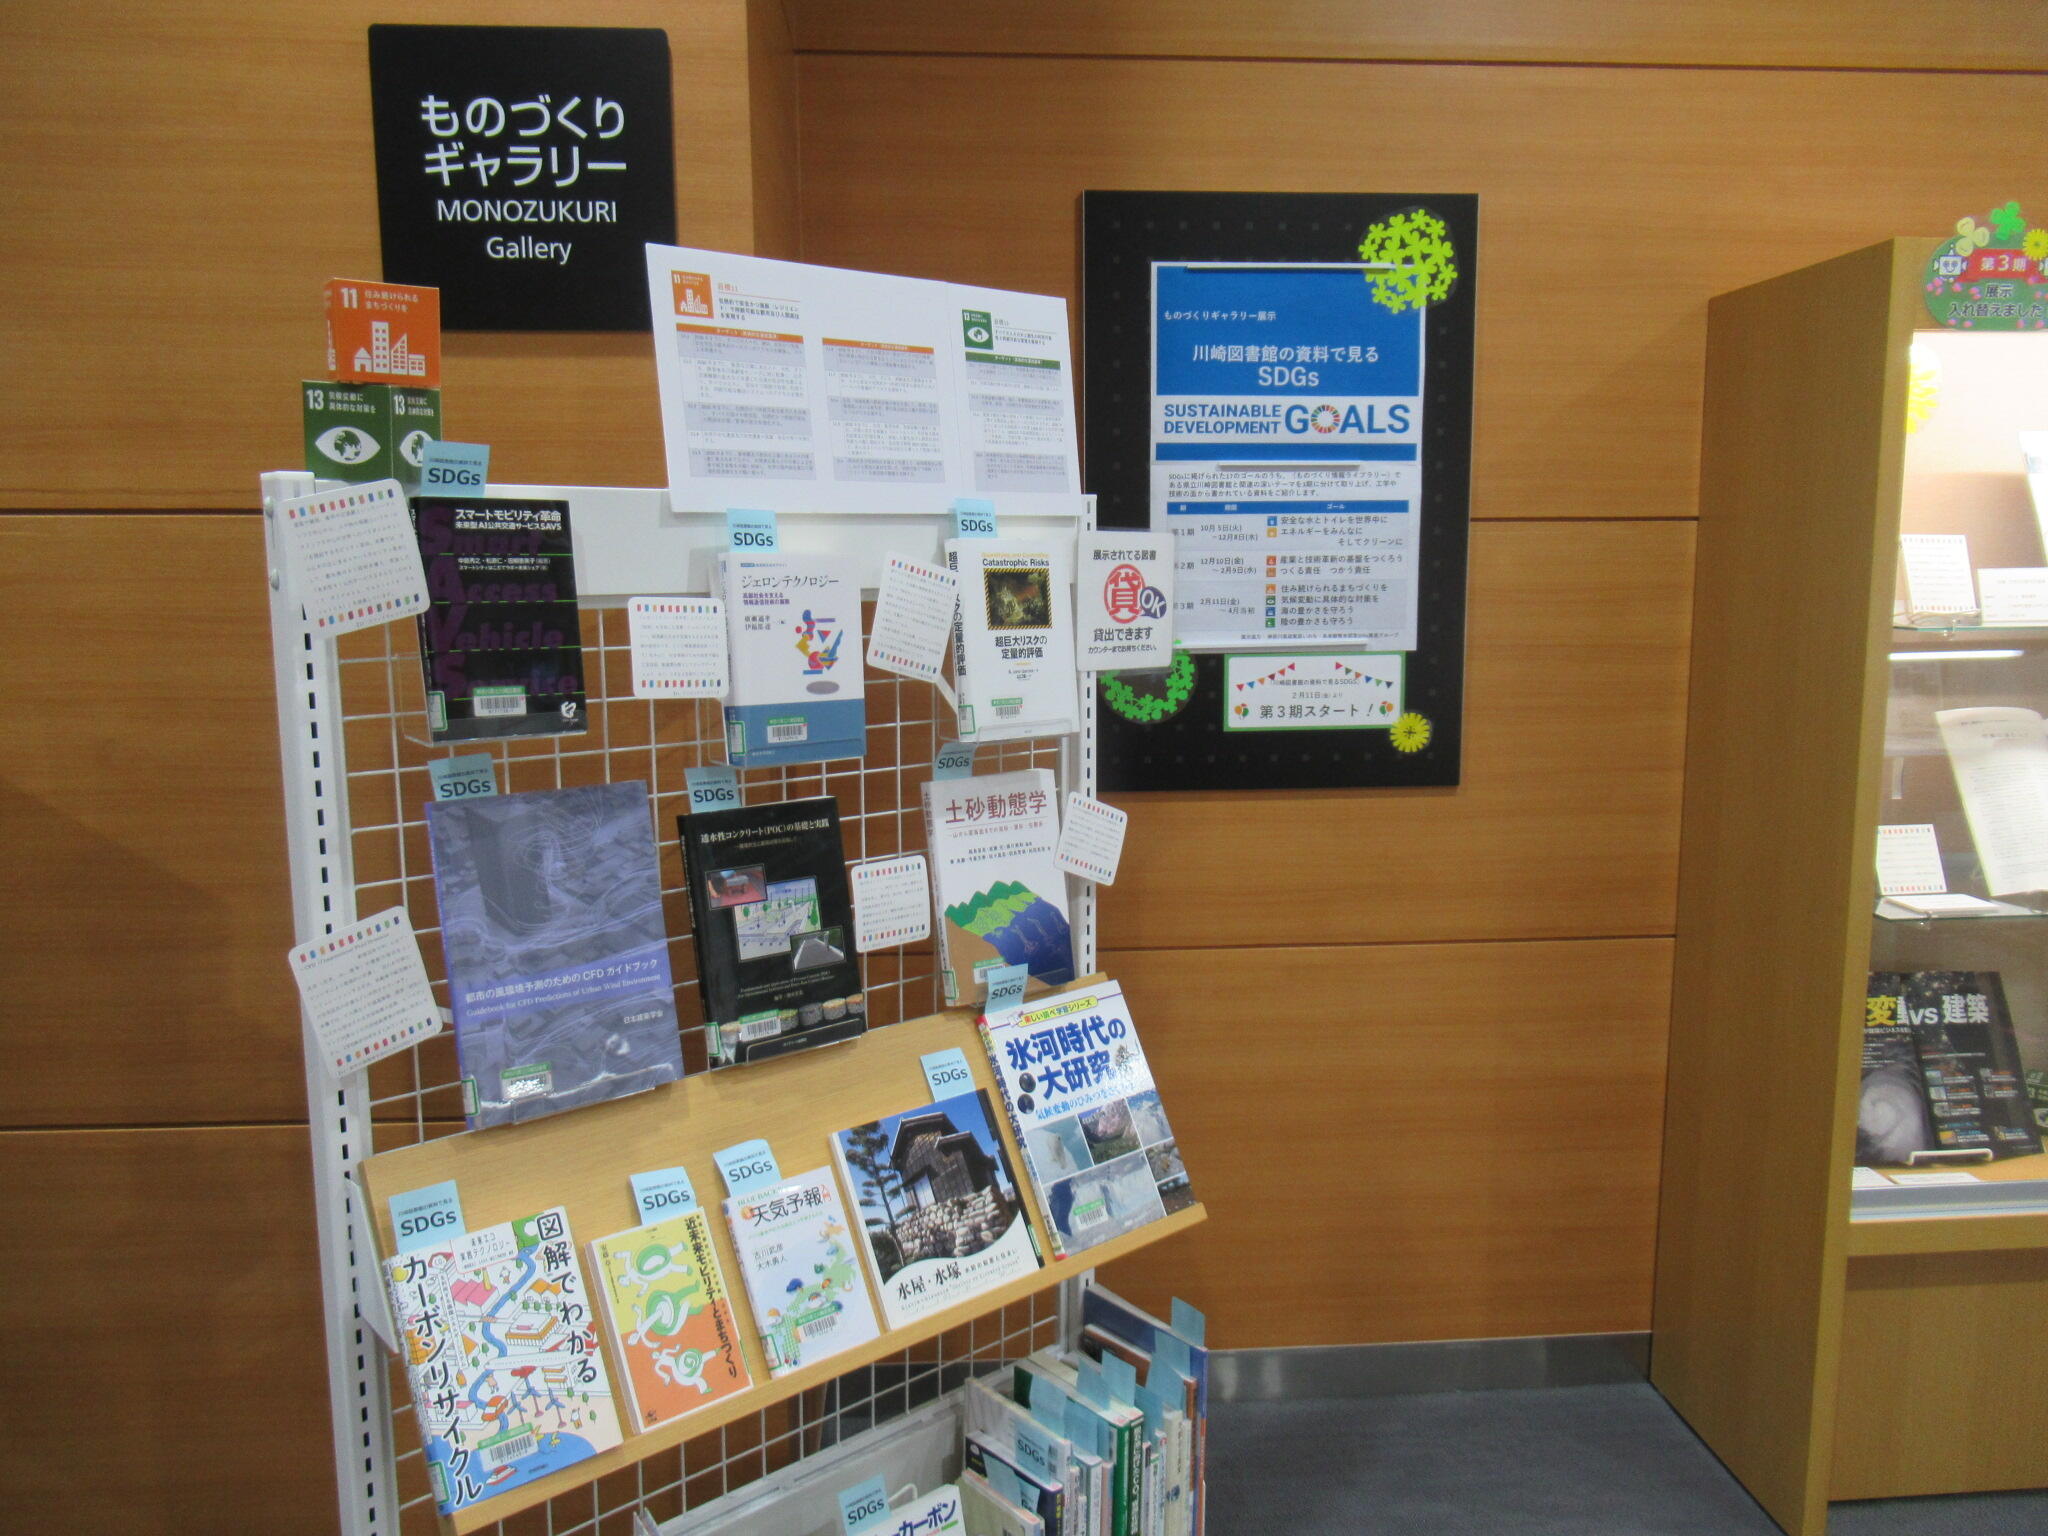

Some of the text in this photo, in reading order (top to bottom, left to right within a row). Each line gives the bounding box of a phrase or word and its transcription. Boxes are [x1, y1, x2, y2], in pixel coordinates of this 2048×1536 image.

[420, 94, 626, 139] ものづくり
[424, 142, 627, 187] ギャラリー
[437, 200, 618, 223] MONOZUKURI
[486, 236, 572, 264] Gallery
[341, 287, 359, 309] 11
[1985, 284, 2015, 299] 展示
[1163, 310, 1277, 322] ものづくりギャラリー展示
[1192, 344, 1379, 364] 川崎図書館の資料で見る
[1257, 366, 1320, 387] SDGs
[306, 389, 325, 410] 13
[393, 395, 406, 416] 13
[1163, 403, 1282, 419] SUSTAINABLE
[1284, 404, 1411, 435] GOALS
[1163, 420, 1281, 434] DEVELOPMENT
[427, 467, 481, 486] SDGs
[455, 508, 562, 522] スマートモビリティ革命
[1280, 515, 1388, 525] 安全な水とトイレを世界中に
[960, 520, 994, 532] SDGs
[1280, 526, 1363, 536] エネルギーをみんなに
[733, 532, 774, 547] SDGs
[1338, 537, 1403, 547] そしてクリーンに
[982, 558, 1050, 569] Catastrophic Risks
[1093, 549, 1157, 561] 展示されてる図書
[1280, 554, 1403, 565] 産業と技術革新の基盤をつくろう
[741, 575, 840, 589] ジェロンテクノロジー
[1280, 583, 1388, 594] 住み続けられるまちづくりを
[1108, 571, 1167, 619] 貸 OK
[995, 635, 1048, 648] 超巨大リスクの
[1093, 626, 1154, 643] 貸出できます
[1001, 647, 1044, 660] 定量的評価
[937, 757, 970, 770] SDGs
[440, 779, 492, 799] SDGs
[693, 787, 735, 803] SDGs
[945, 790, 1048, 824] 土砂動態学
[582, 968, 605, 982] CFD
[606, 958, 658, 976] ガイドブック
[991, 983, 1023, 1000] SDGs
[1941, 993, 1990, 1025] 建築
[1005, 1014, 1126, 1071] 氷河時代の
[931, 1068, 969, 1086] SDGs
[1037, 1049, 1112, 1100] 大研究
[728, 1160, 773, 1183] SDGs
[642, 1189, 691, 1211] SDGs
[750, 1185, 823, 1227] 天気予報
[400, 1210, 457, 1237] SDGs
[536, 1212, 598, 1385] 図解でわかる
[402, 1255, 483, 1507] カーボンリサイクル
[1017, 1440, 1046, 1466] SDGs
[847, 1498, 885, 1525] SDGs
